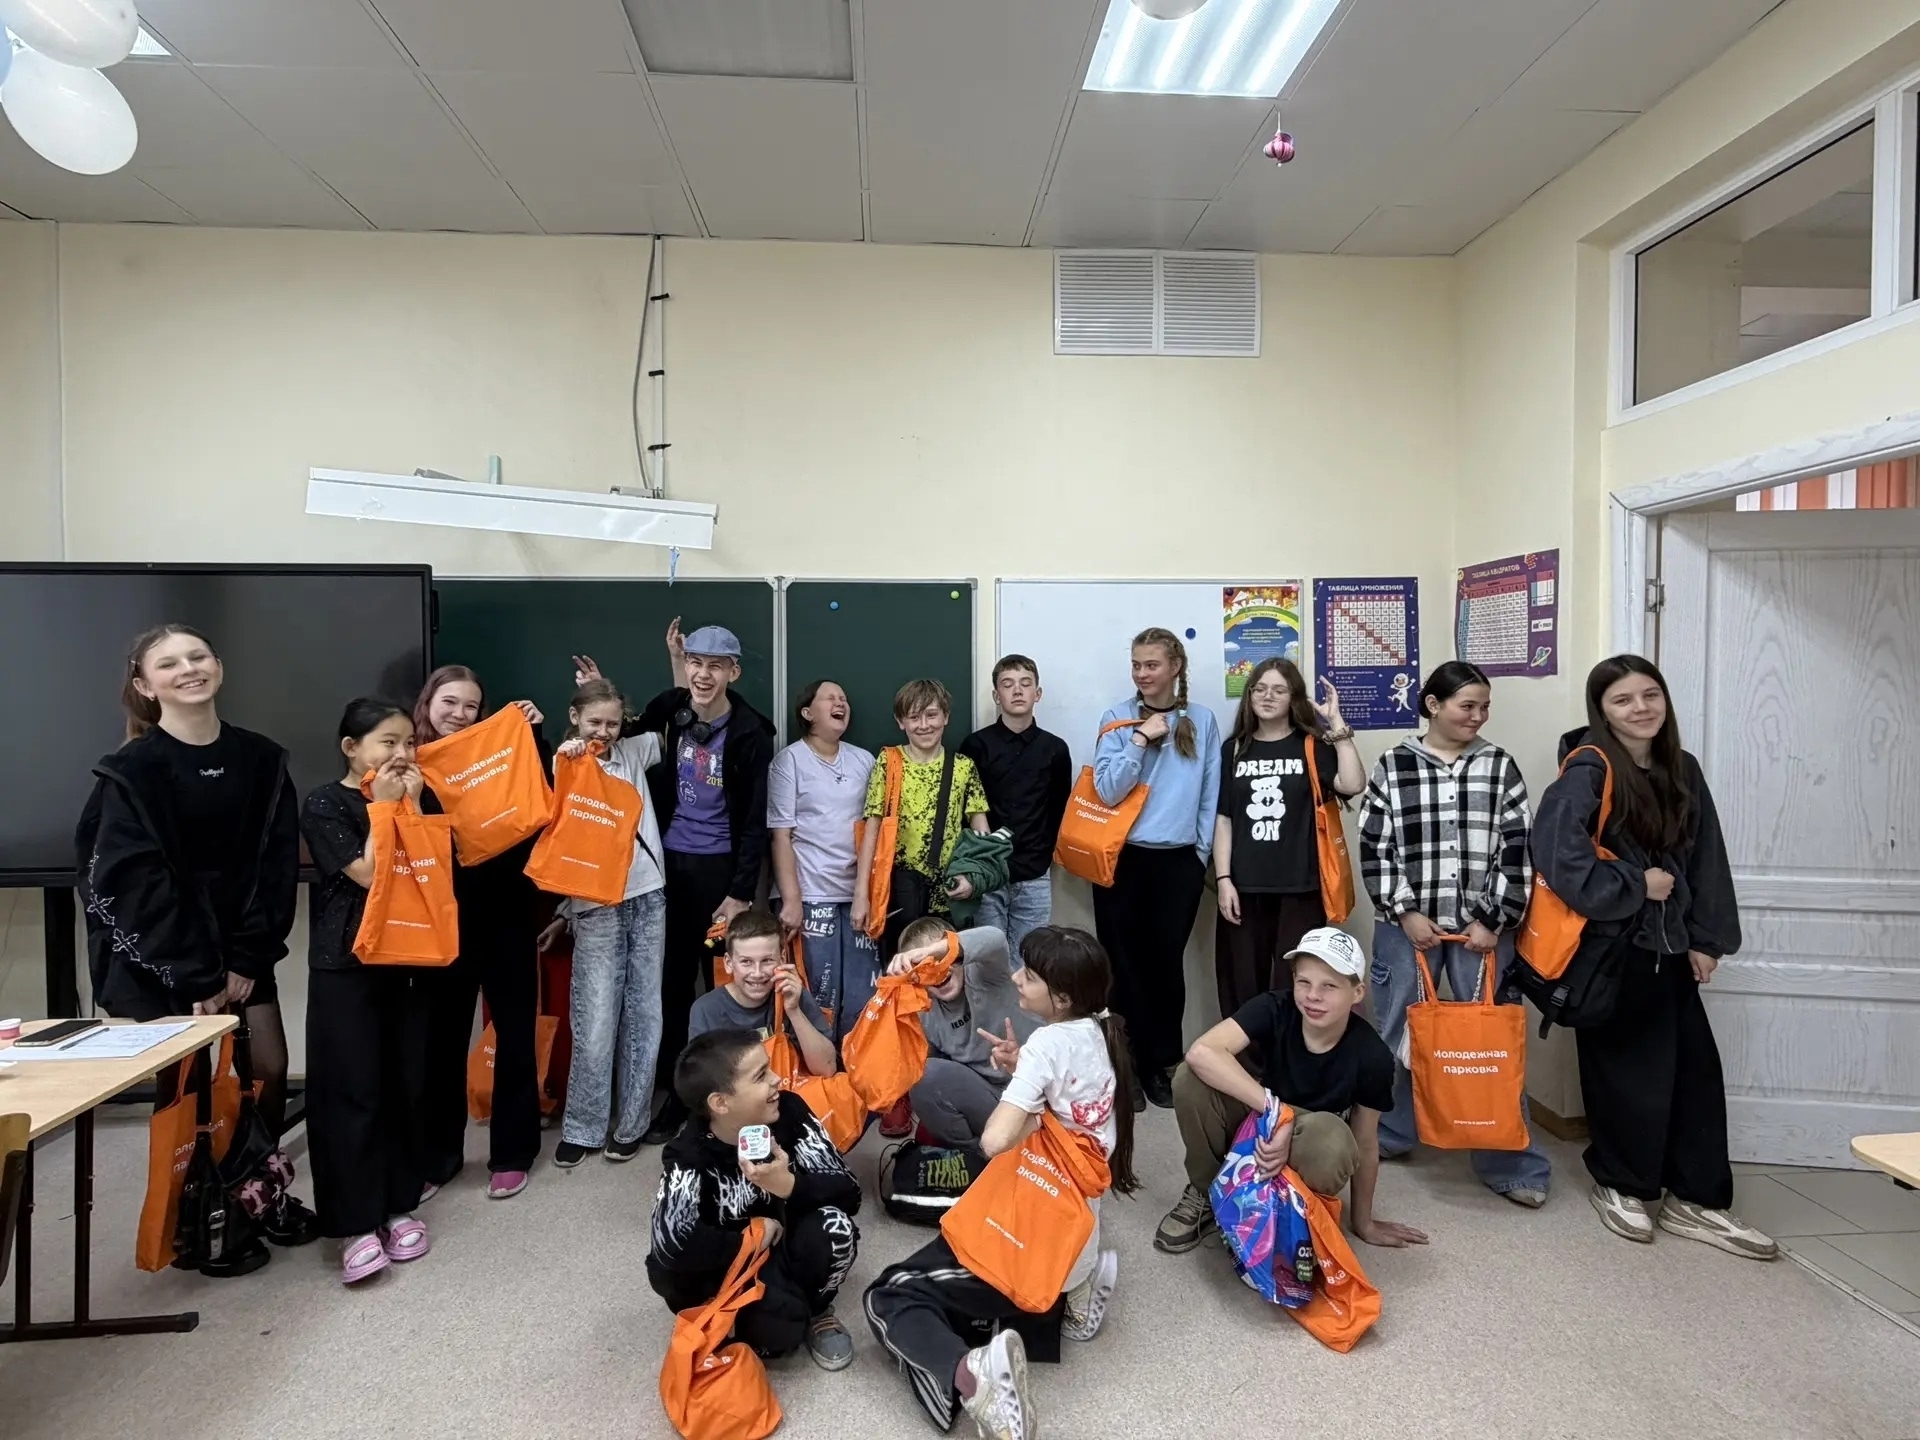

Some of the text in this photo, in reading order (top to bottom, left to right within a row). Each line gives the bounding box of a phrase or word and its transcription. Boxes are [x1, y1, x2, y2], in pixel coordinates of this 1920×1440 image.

[445, 746, 513, 785] Молодежная
[1235, 758, 1304, 778] DREAM
[461, 763, 509, 792] парковка
[1251, 820, 1281, 841] ON
[811, 907, 834, 919] MORE
[804, 919, 835, 935] ULES
[1433, 1049, 1508, 1060] Молодежная
[1443, 1065, 1499, 1075] парковка
